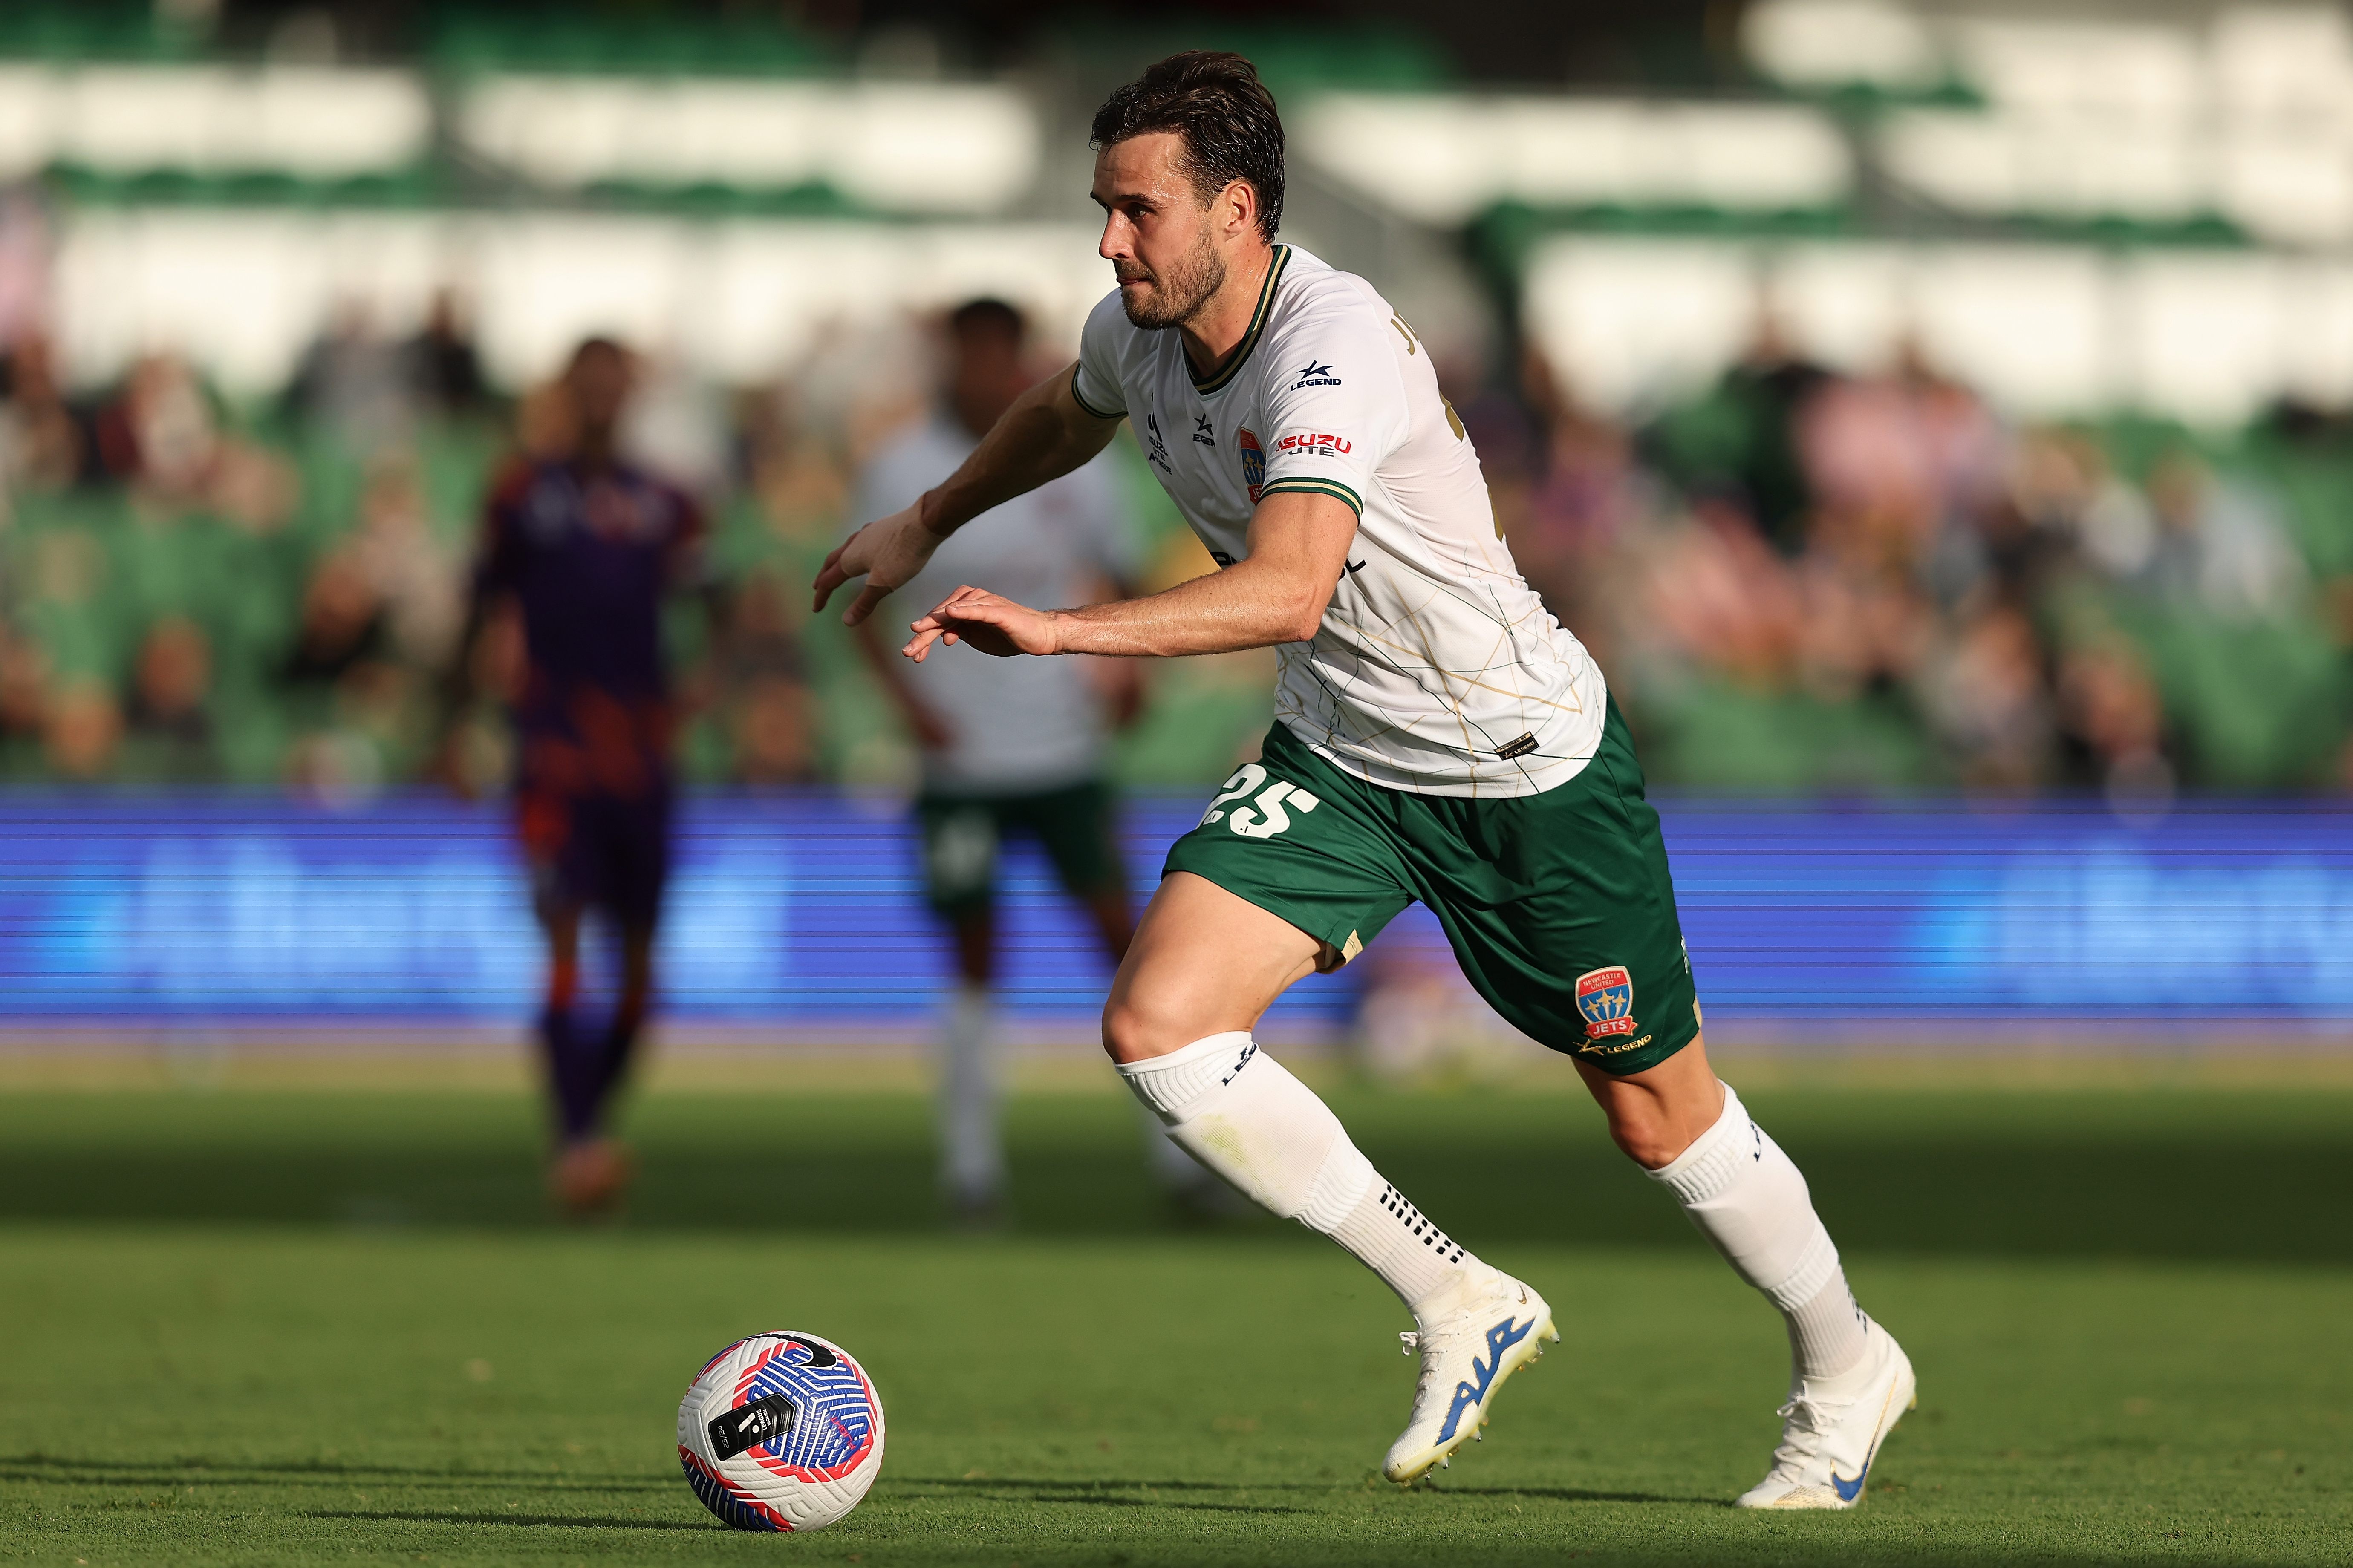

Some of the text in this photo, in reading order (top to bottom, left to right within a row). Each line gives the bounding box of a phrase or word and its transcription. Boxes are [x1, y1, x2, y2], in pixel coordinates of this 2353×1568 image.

[1290, 378, 1342, 392] LEGEND
[1276, 434, 1351, 454] ISUZU
[1514, 741, 1535, 754] LEGEND
[1195, 763, 1320, 839] 25
[1582, 972, 1621, 987] NEWCASTLE
[1591, 979, 1614, 989] UNITED
[1593, 1020, 1627, 1035] JETS
[1607, 1035, 1652, 1054] LEGEND
[756, 1409, 767, 1431] LEAGUE
[763, 1409, 771, 1426] WOMEN
[717, 1425, 730, 1449] 23/24
[830, 1416, 856, 1450] FLIGHT
